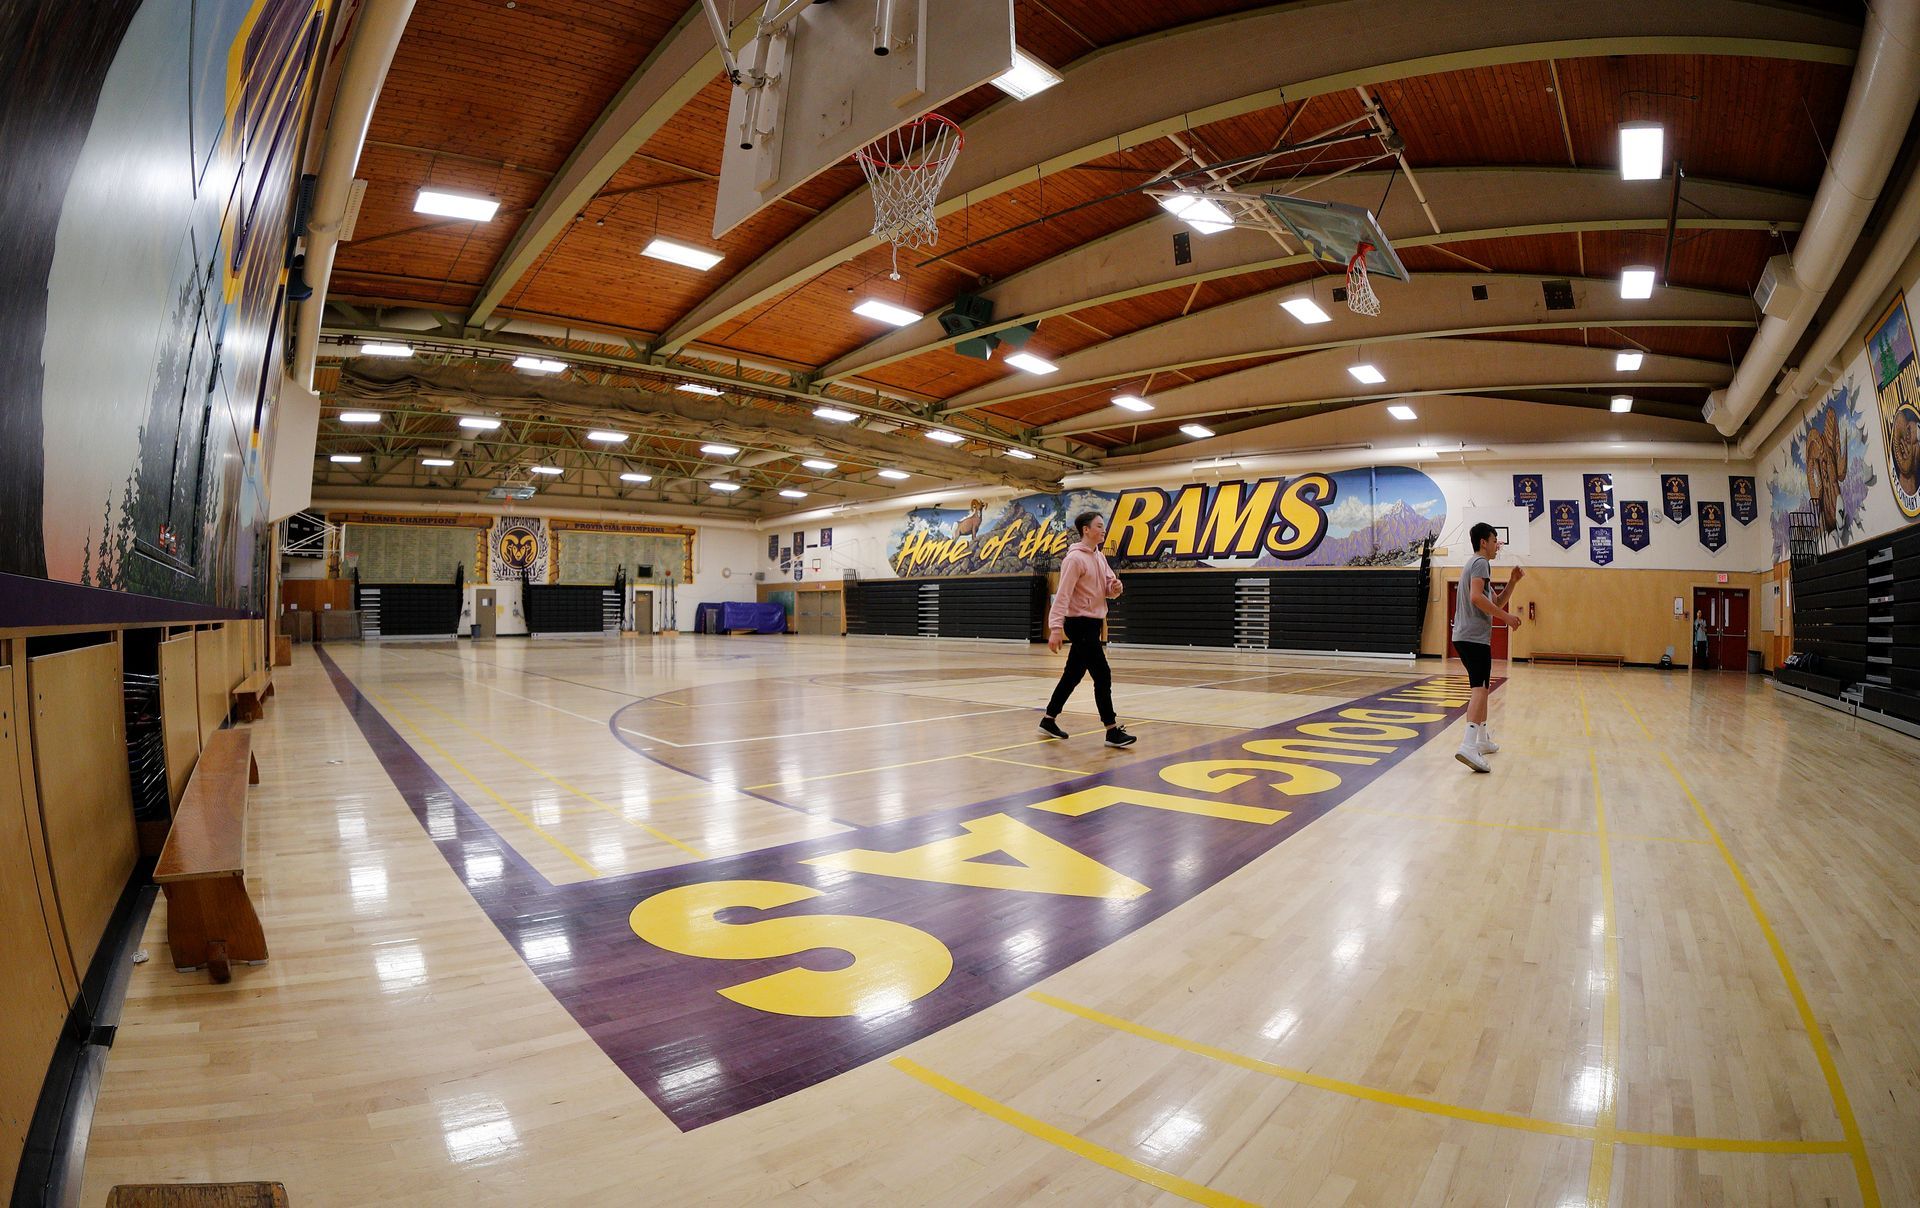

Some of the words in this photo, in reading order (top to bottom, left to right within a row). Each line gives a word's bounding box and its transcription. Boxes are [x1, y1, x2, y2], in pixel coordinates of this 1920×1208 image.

[362, 515, 397, 523] ISLAND
[574, 523, 620, 531] PROVINCIAL
[621, 525, 665, 533] CHAMPIONS
[1103, 473, 1337, 560] RAMS
[896, 529, 972, 577] Home
[980, 518, 1022, 568] of
[1018, 511, 1068, 561] the
[502, 561, 538, 577] HISTRY
[628, 707, 1448, 1018] DOUGLAS
